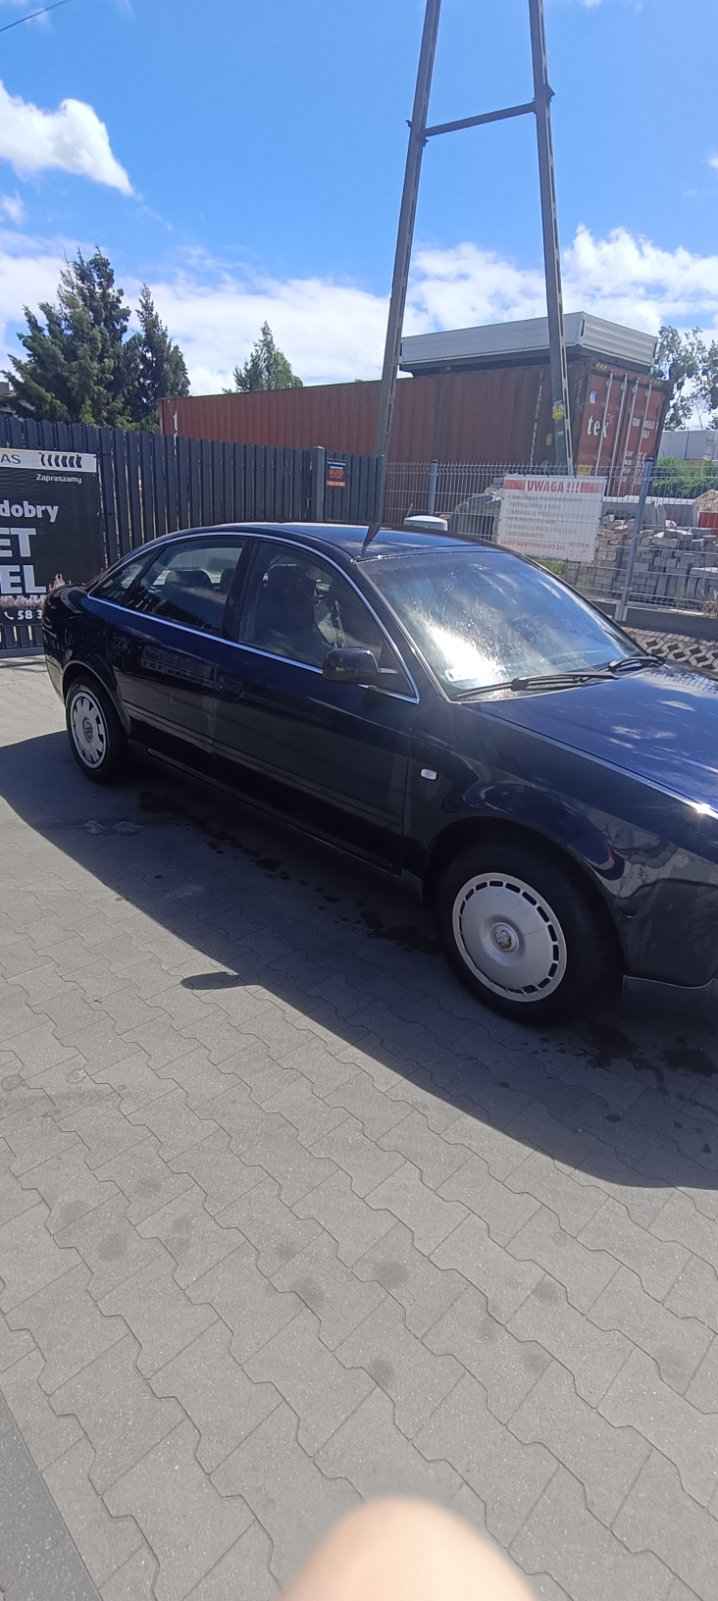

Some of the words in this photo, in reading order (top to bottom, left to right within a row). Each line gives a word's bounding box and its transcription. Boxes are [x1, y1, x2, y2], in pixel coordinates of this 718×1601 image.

[36, 473, 82, 484] Zapraszamy
[527, 480, 564, 493] UWAGA
[0, 500, 59, 523] dobry
[0, 565, 47, 594] EL
[17, 610, 33, 620] 58
